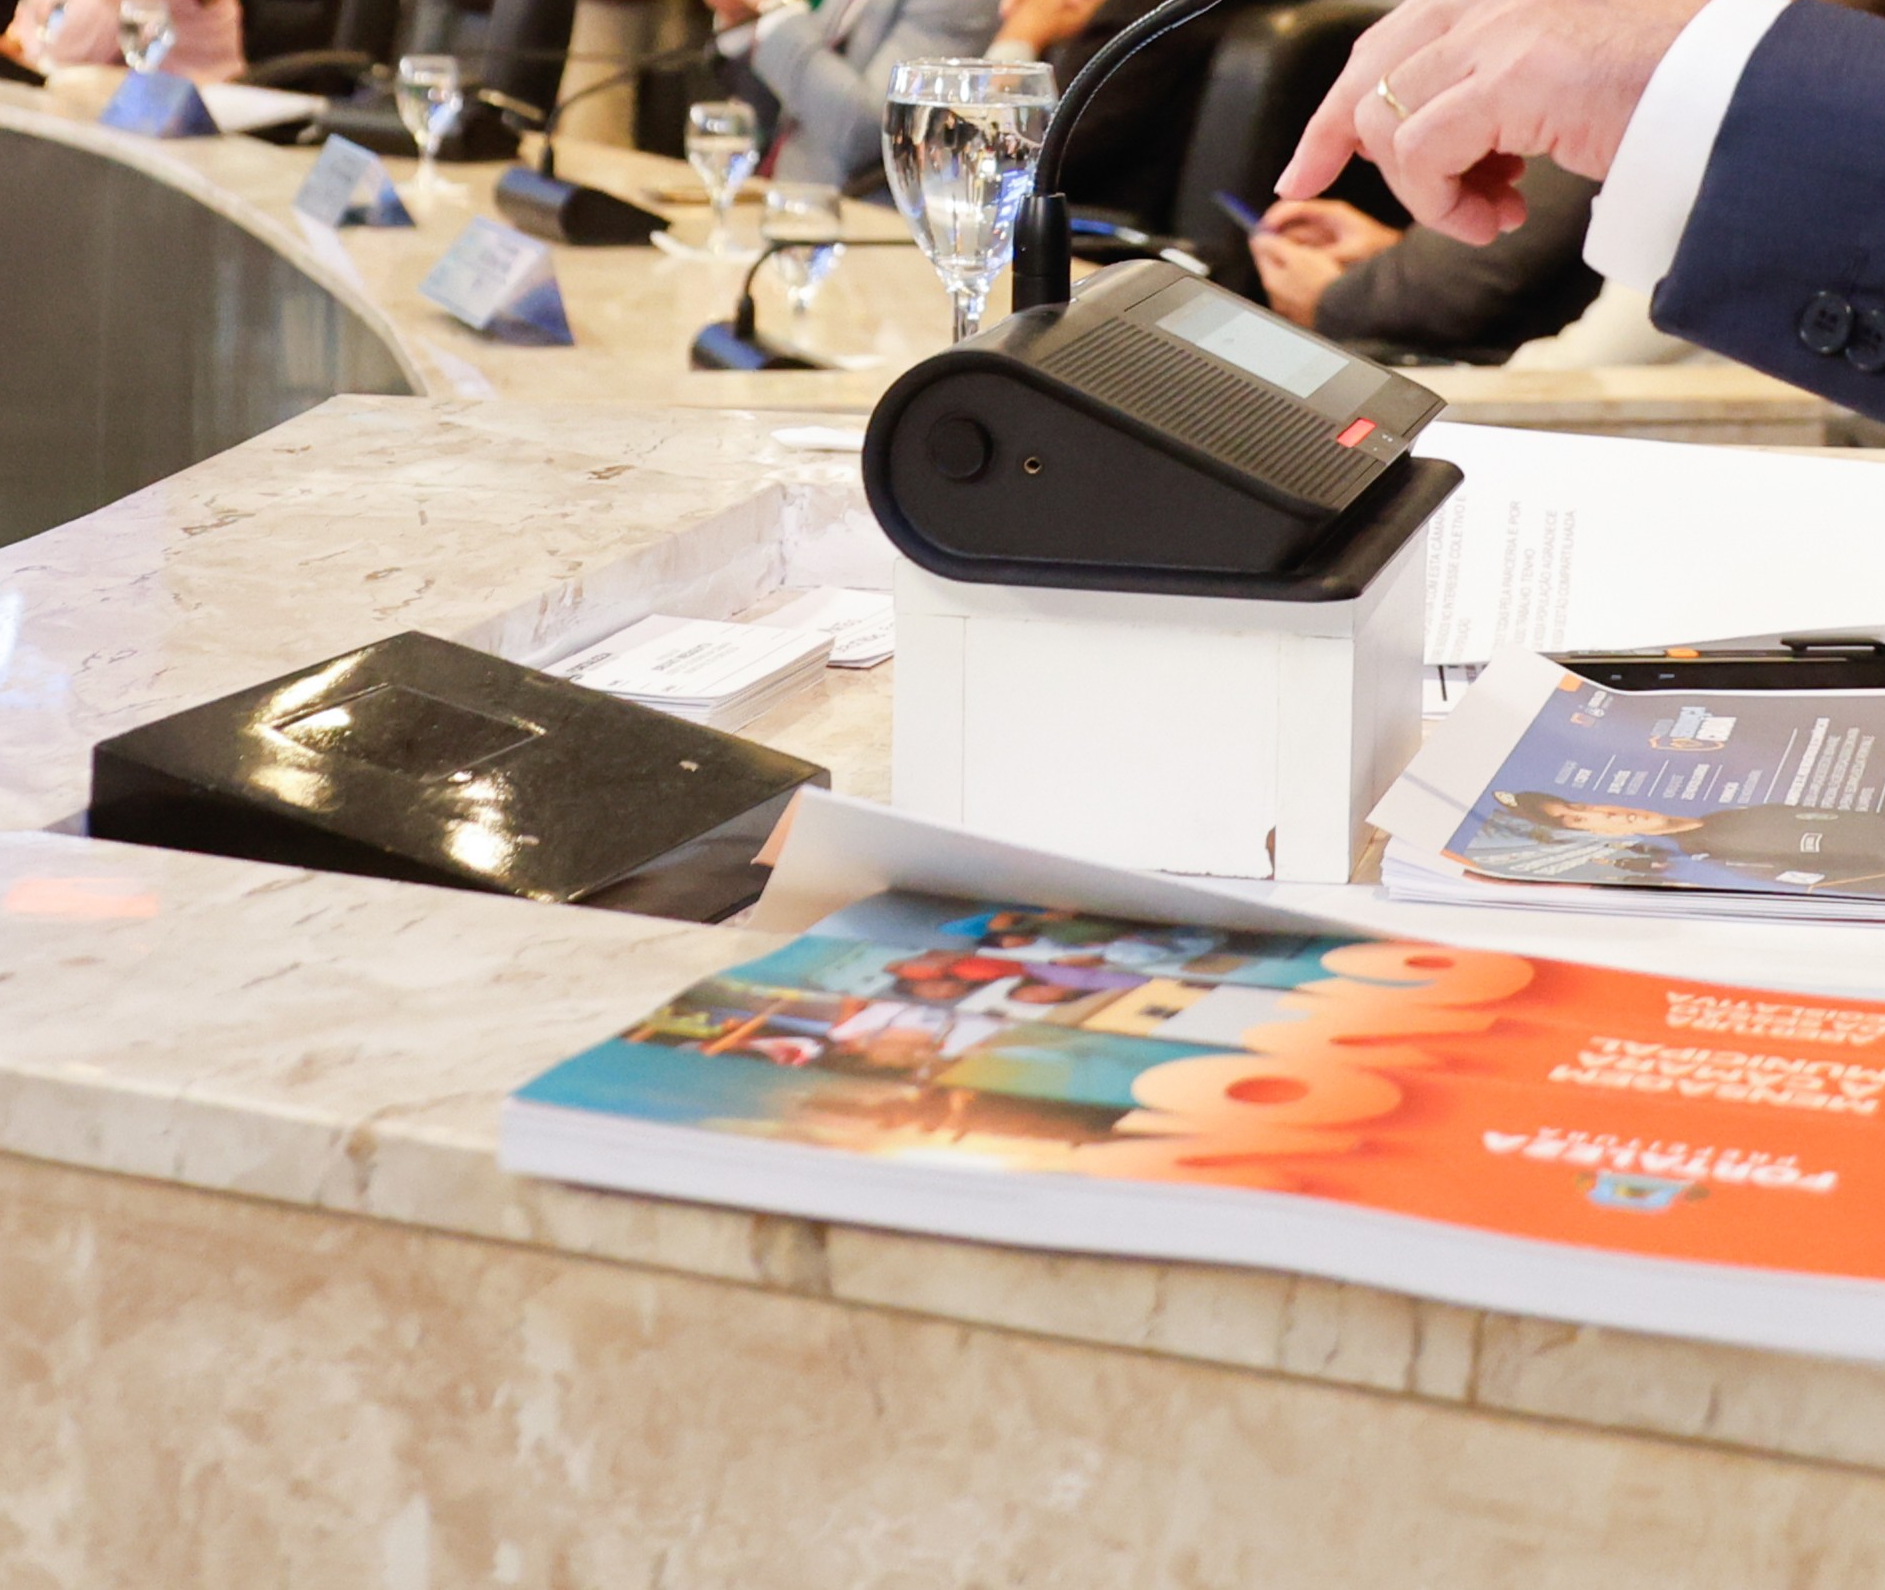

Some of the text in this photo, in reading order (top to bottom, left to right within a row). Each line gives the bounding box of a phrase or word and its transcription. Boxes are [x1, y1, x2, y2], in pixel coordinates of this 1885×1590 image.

[1430, 504, 1446, 549] CÂMAR
[1449, 504, 1465, 558] COLETIVO
[1508, 500, 1521, 524] POR
[1502, 537, 1517, 586] PARCERIA
[1541, 509, 1556, 568] AGRADECE
[1429, 552, 1441, 576] ESTA
[1520, 547, 1535, 580] TENHO
[1549, 1064, 1879, 1115] MENSAGEM
[1483, 1131, 1838, 1192] FORTALEZA
